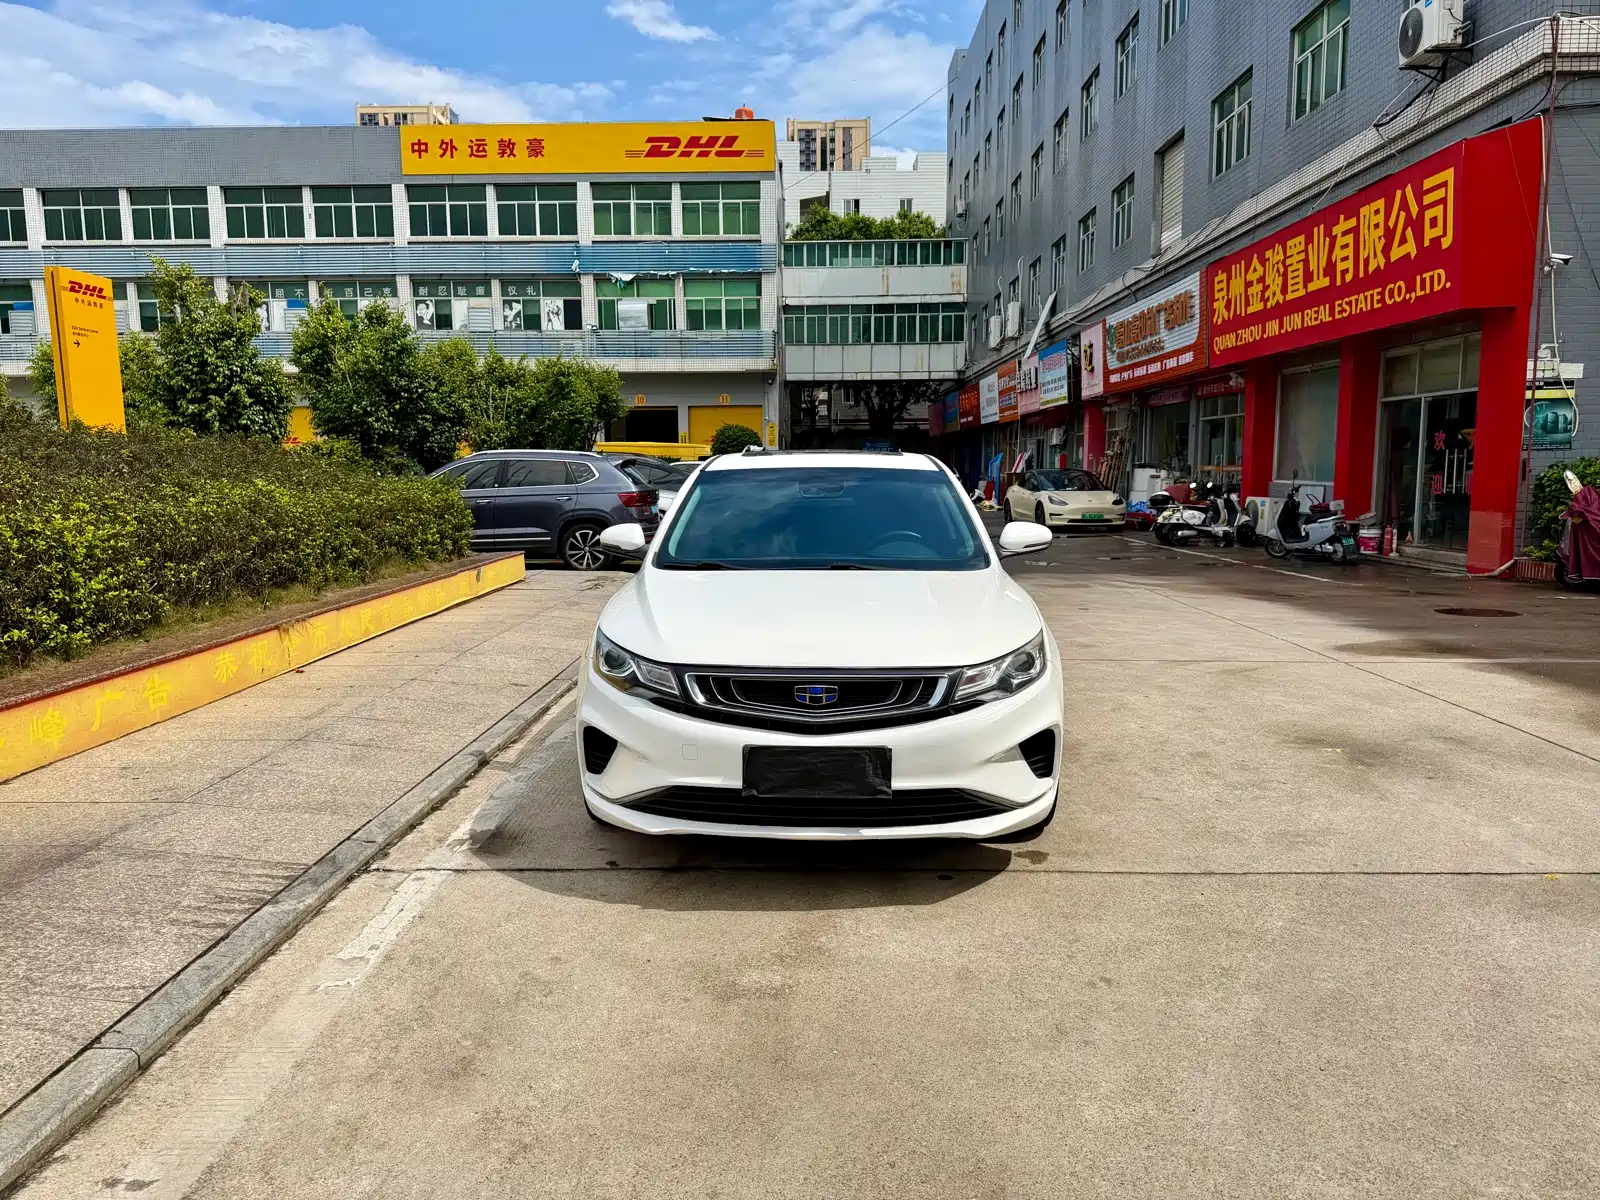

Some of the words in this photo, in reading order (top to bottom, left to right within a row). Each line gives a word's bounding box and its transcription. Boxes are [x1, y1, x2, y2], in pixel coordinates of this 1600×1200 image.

[410, 137, 546, 160] 中外运敦豪
[644, 135, 749, 158] DHL
[1212, 166, 1455, 326] 泉州金骏置业有限公司
[68, 280, 107, 299] DHL
[1213, 331, 1236, 354] QUAN
[1237, 325, 1262, 347] ZHOU
[1263, 319, 1279, 342] JIN
[1280, 311, 1302, 334] JUN
[1303, 303, 1333, 328] REAL
[1335, 288, 1382, 320] ESTATE
[0, 673, 173, 752] 峰广告
